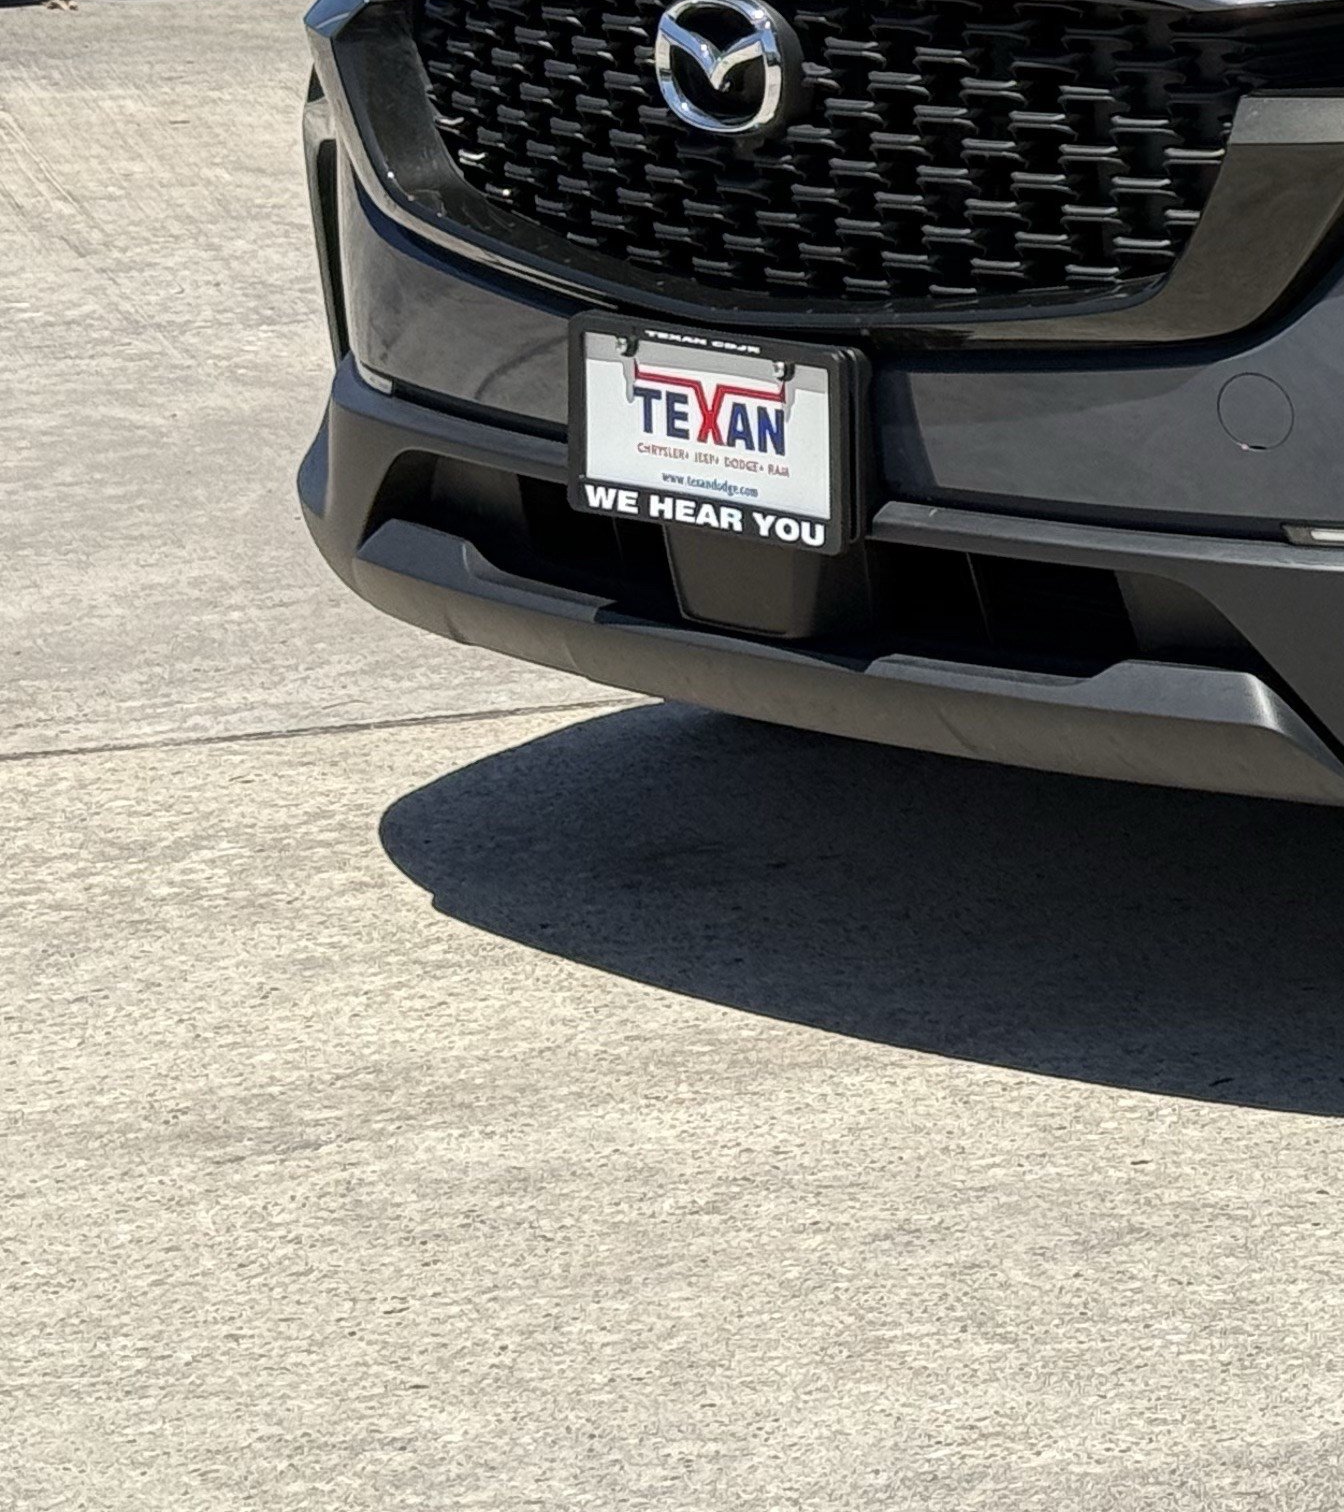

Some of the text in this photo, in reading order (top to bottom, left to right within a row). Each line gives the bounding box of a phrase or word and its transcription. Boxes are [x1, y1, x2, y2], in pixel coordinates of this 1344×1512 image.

[633, 376, 786, 456] TEXAN
[637, 442, 685, 460] CHRYSLER
[724, 456, 759, 473] DODGE
[768, 463, 790, 478] RAM
[662, 472, 759, 498] www.texandodge.com
[584, 484, 826, 547] WE HEAR YOU
